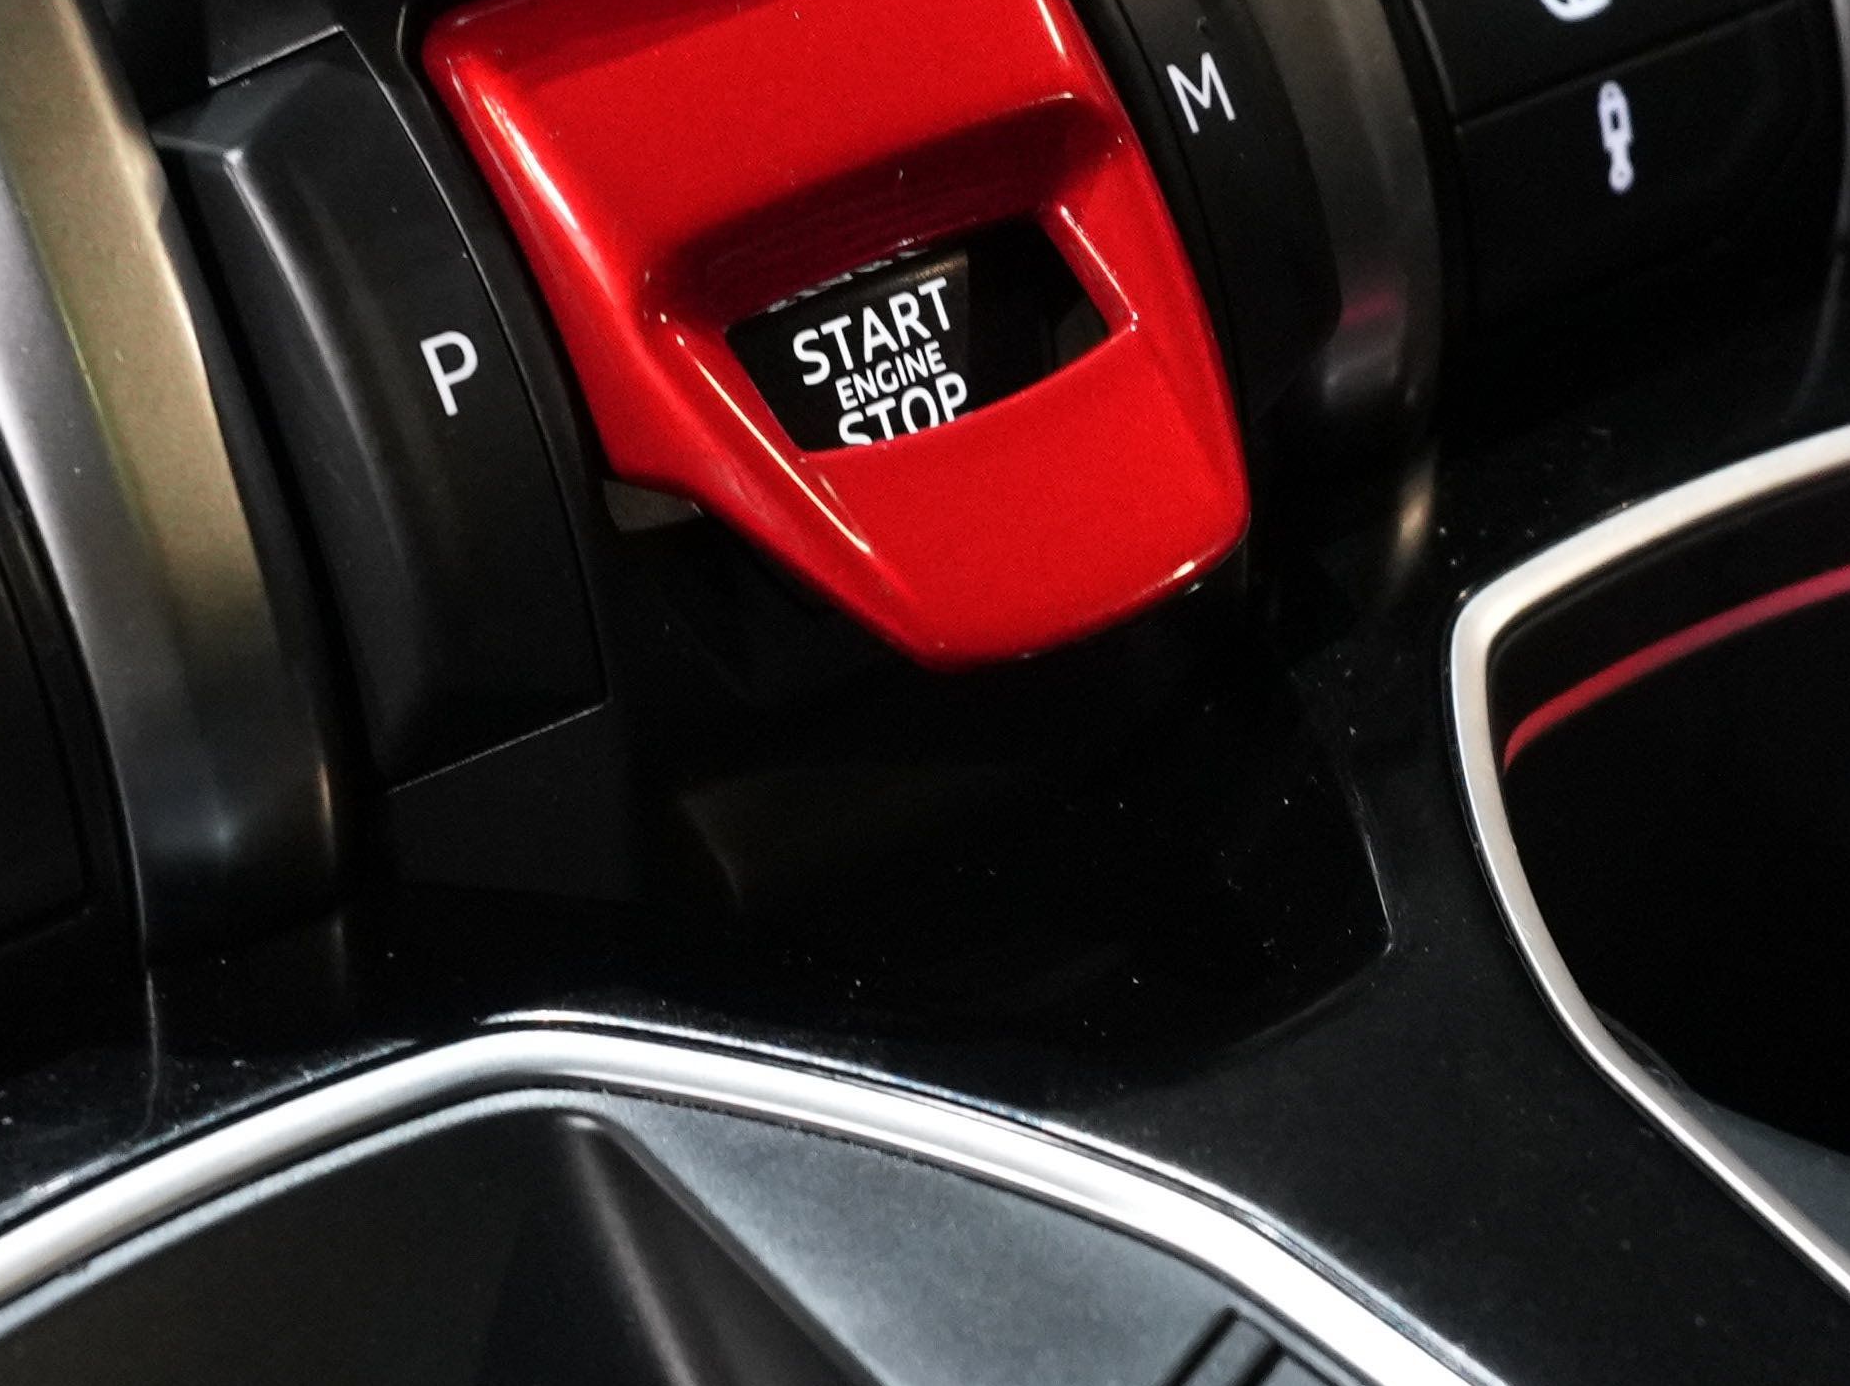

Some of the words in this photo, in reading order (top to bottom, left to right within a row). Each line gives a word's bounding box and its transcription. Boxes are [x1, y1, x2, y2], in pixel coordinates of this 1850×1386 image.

[1165, 51, 1237, 135] M
[419, 330, 480, 417] P
[792, 277, 952, 387] START
[834, 340, 947, 412] ENGINE
[837, 371, 969, 446] STOP
